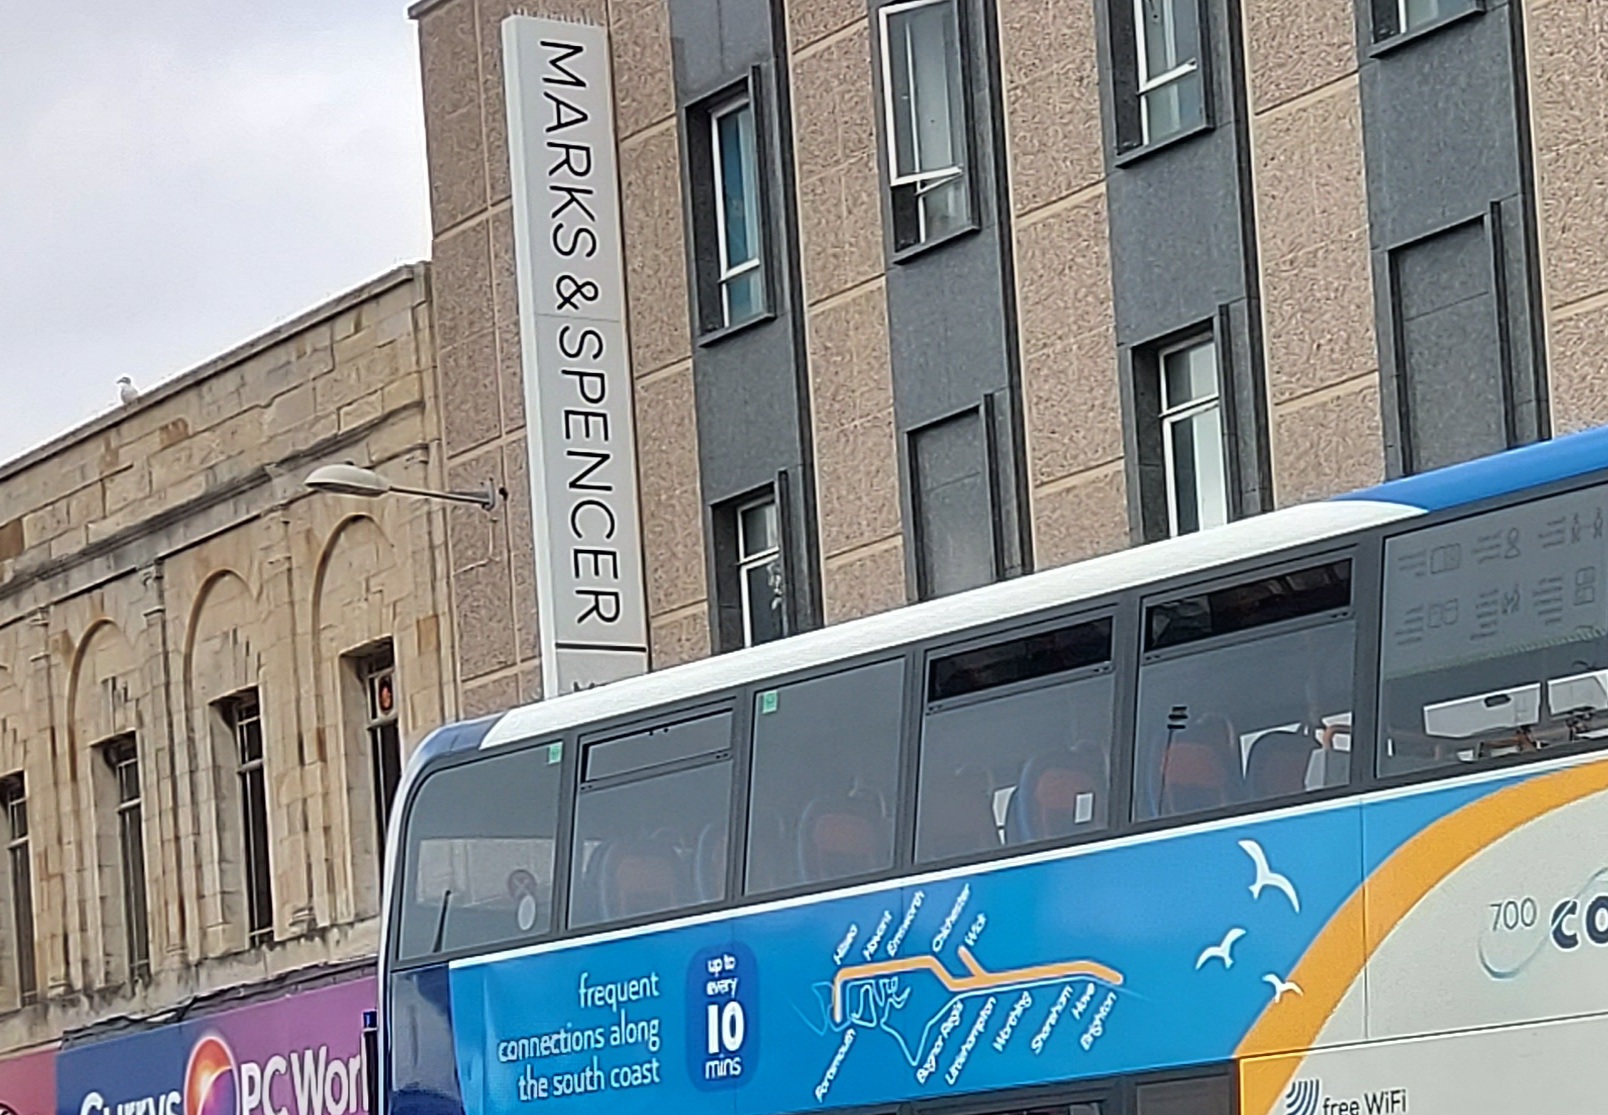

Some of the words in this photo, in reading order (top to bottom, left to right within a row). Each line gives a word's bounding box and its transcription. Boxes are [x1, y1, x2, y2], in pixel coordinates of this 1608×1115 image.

[538, 38, 599, 260] MARKS
[555, 273, 600, 311] &
[558, 324, 621, 627] SPENCER
[1490, 896, 1538, 932] 700
[707, 956, 723, 978] up
[723, 953, 736, 971] to
[578, 971, 660, 1013] frequent
[706, 976, 738, 998] every
[498, 1021, 605, 1063] connections
[609, 1008, 660, 1052] along
[707, 1000, 745, 1055] 10
[518, 1063, 549, 1101] the
[553, 1055, 605, 1096] south
[610, 1057, 661, 1089] coast
[704, 1052, 742, 1080] mins
